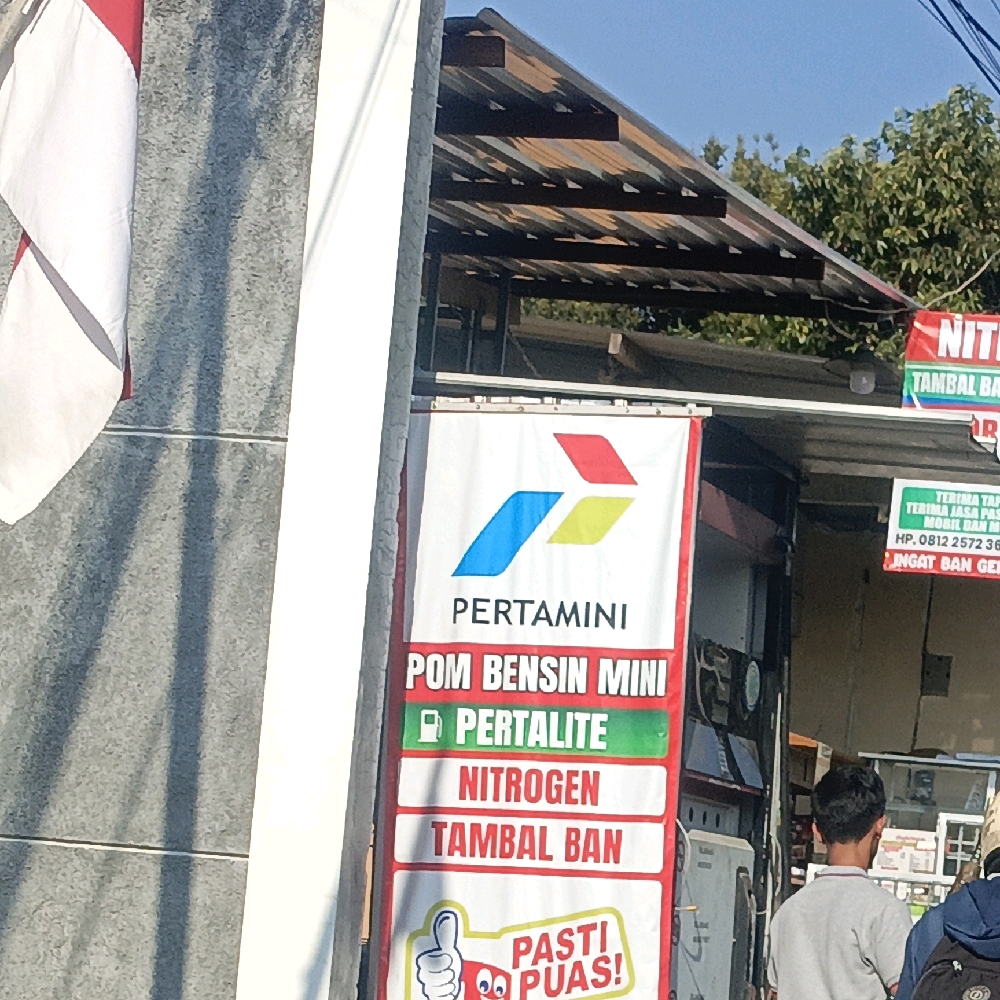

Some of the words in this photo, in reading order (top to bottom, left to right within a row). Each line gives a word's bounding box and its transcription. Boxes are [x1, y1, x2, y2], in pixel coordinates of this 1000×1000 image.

[912, 371, 976, 395] TAMBAL
[906, 502, 948, 516] TERIMA
[950, 506, 978, 519] JASA
[936, 491, 979, 507] TERIMA
[923, 515, 962, 531] MOBIL
[896, 534, 917, 546] HP.
[919, 535, 948, 548] 0812
[952, 536, 982, 550] 2572
[940, 556, 973, 573] BAN
[453, 598, 627, 630] PERTAMINI
[406, 653, 471, 691] POM
[482, 654, 588, 695] BENSIN
[598, 658, 667, 698] MINI
[456, 707, 609, 751] PERTALITE
[459, 766, 600, 807] NITROGEN
[431, 821, 553, 861] TAMBAL
[564, 827, 623, 864] BAN
[512, 921, 608, 969] PASTI
